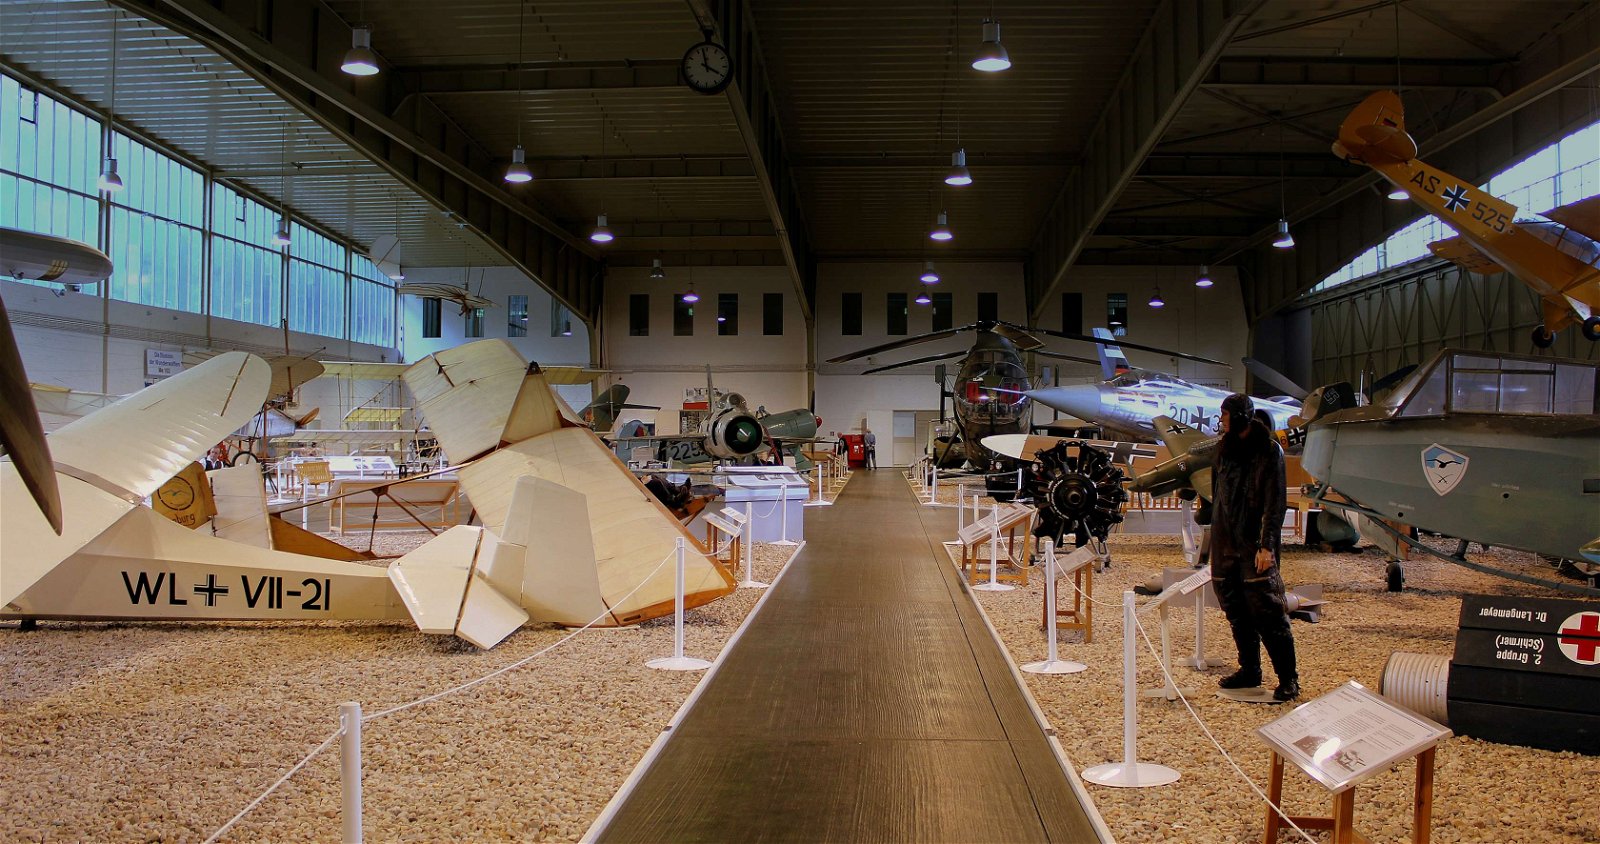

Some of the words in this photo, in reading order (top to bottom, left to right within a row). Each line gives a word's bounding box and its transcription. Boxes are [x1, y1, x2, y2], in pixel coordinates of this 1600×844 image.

[1410, 170, 1440, 194] AS
[1472, 201, 1509, 232] 525
[121, 571, 188, 605] WL
[1479, 606, 1532, 622] Langemeyer
[1535, 611, 1547, 622] Dr.
[1495, 634, 1544, 653] (Schirmer)
[1496, 649, 1529, 664] Gruppe
[1533, 653, 1542, 665] 2.
